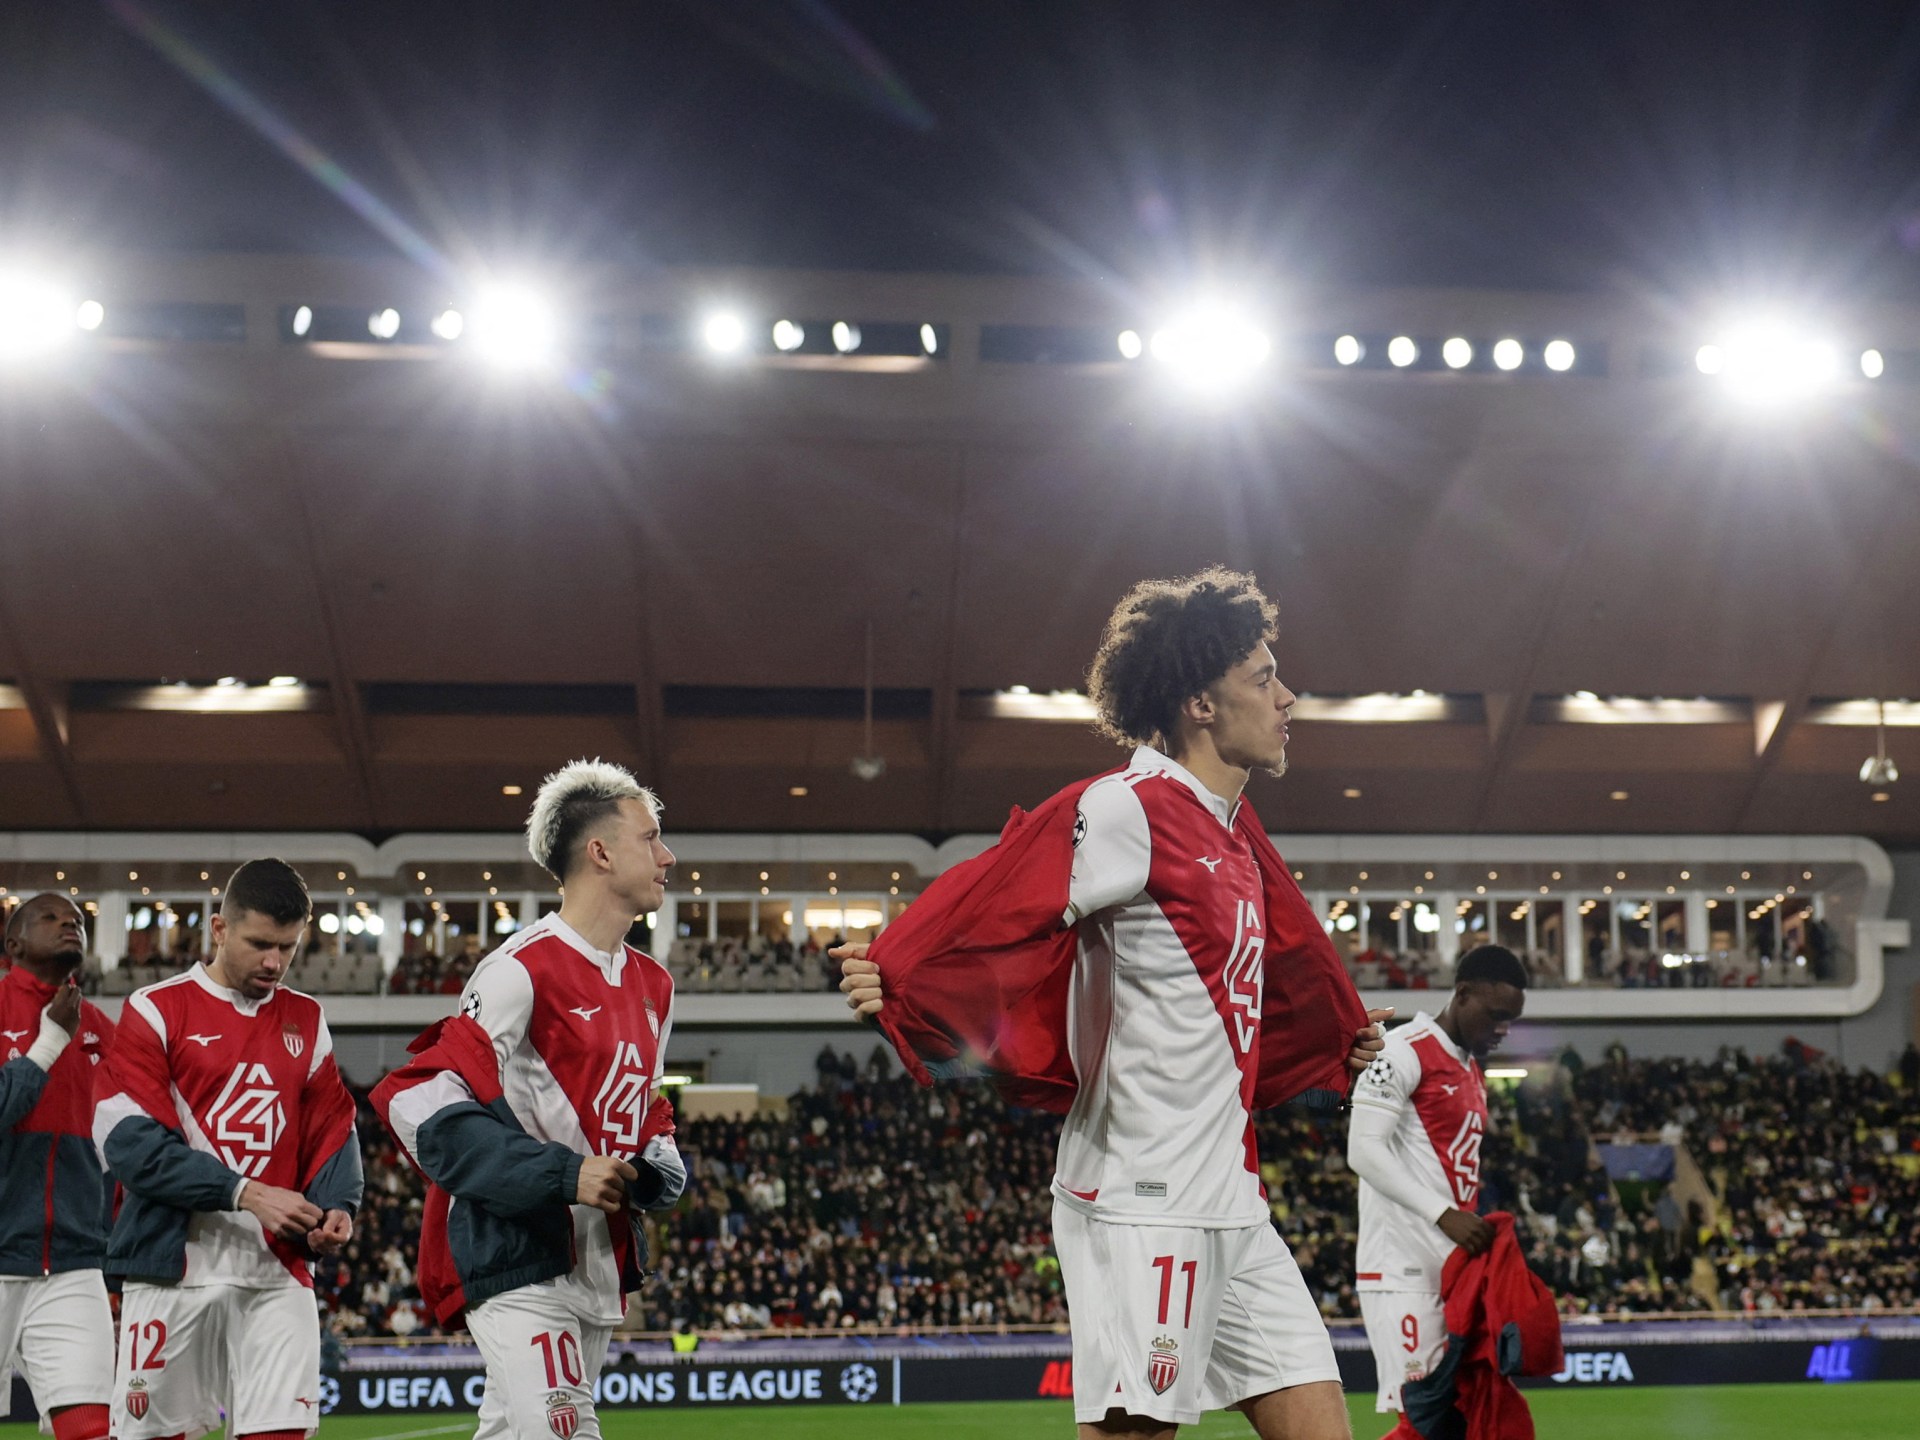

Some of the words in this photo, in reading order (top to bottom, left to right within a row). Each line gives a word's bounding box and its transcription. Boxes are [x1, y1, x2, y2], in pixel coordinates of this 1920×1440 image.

[1152, 1255, 1197, 1330] 11
[128, 1319, 167, 1371] 12
[1402, 1313, 1419, 1353] 9
[531, 1330, 583, 1388] 10
[1806, 1344, 1853, 1378] ALL
[357, 1377, 455, 1409] UEFA
[462, 1371, 676, 1407] CIONS
[687, 1368, 823, 1401] LEAGUE
